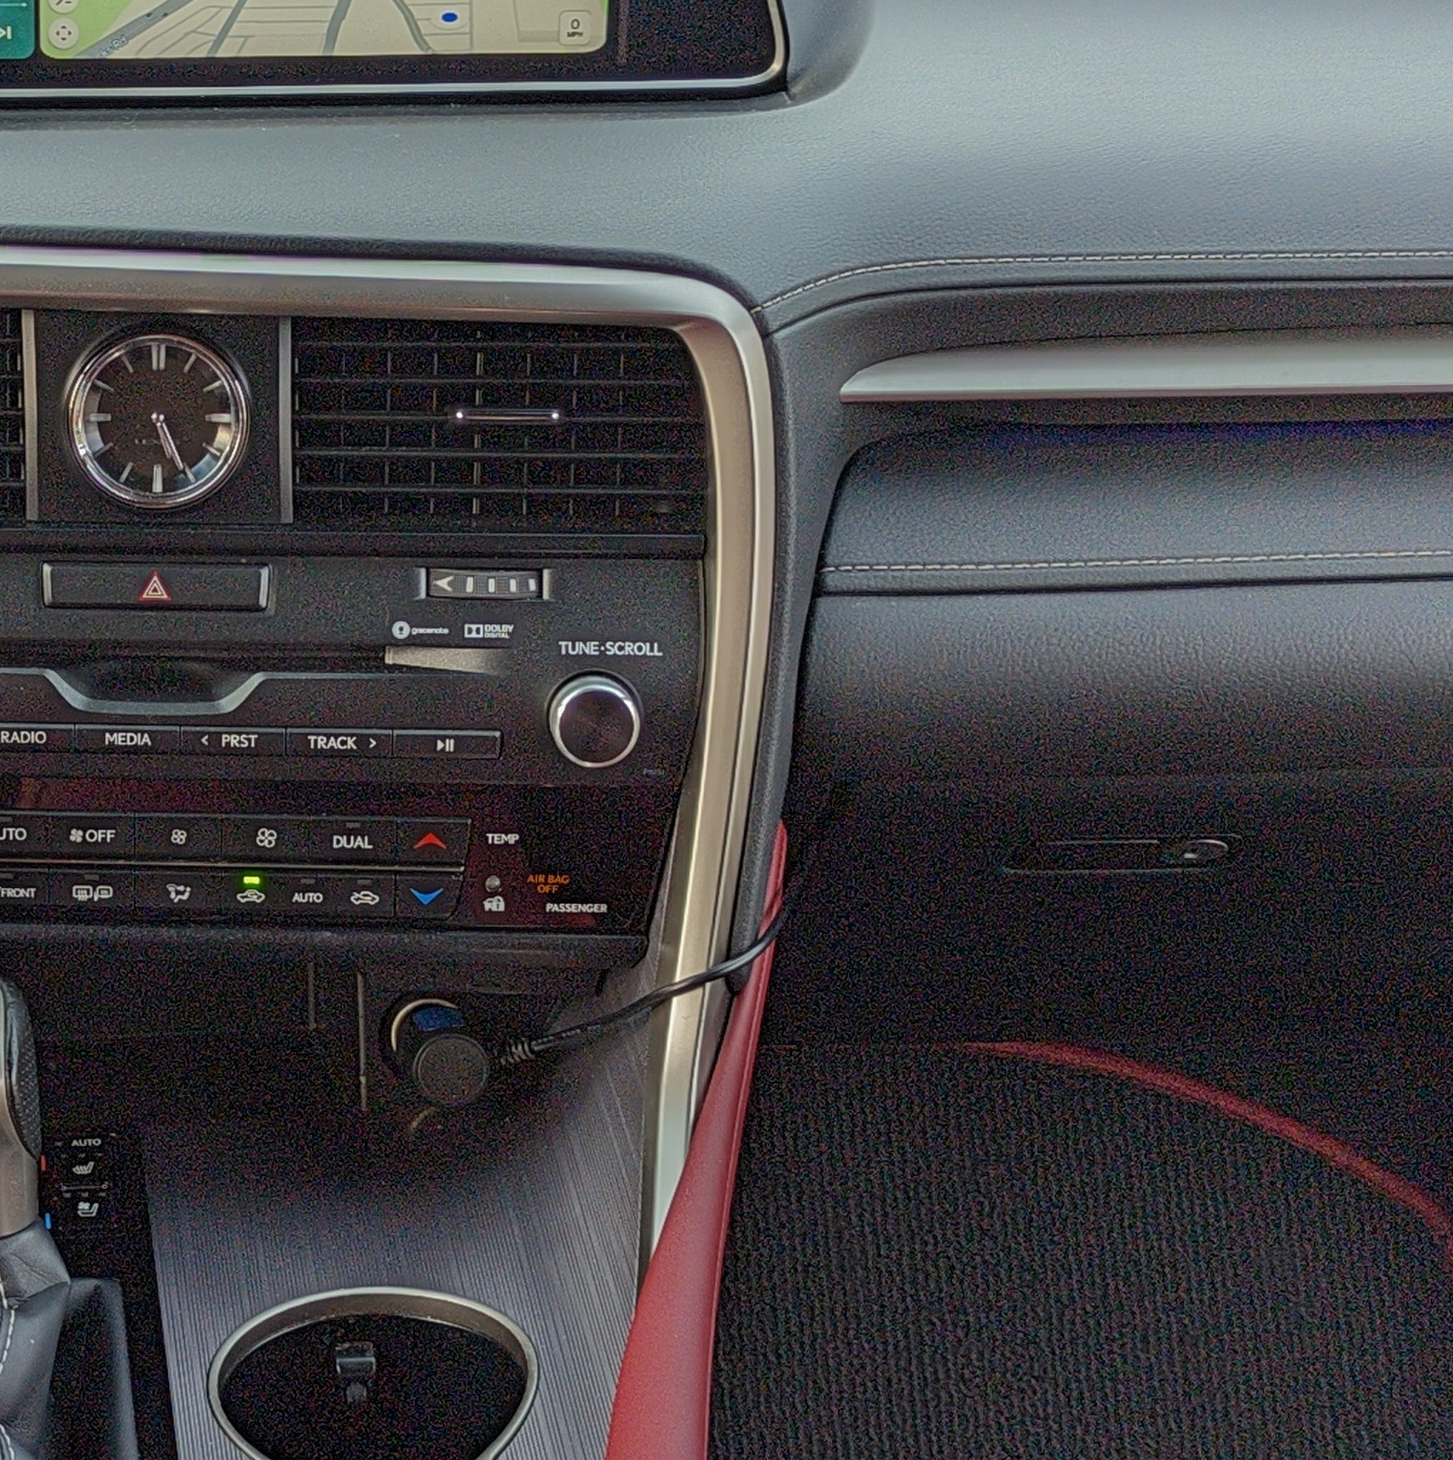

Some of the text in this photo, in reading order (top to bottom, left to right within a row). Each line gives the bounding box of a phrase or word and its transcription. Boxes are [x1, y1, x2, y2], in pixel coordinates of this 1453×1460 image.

[571, 19, 580, 30] 0
[484, 624, 514, 632] DOLBY
[0, 730, 47, 745] RADIO
[105, 732, 151, 747] MEDIA
[221, 734, 258, 749] PRST
[307, 736, 357, 751] TRACK
[85, 829, 116, 843] OFF
[332, 835, 373, 849] DUAL
[486, 833, 520, 845] TEMP
[527, 874, 570, 885] AIR BAG
[0, 887, 37, 899] FRONT
[537, 885, 558, 894] OFF
[292, 892, 323, 903] AUTO
[546, 902, 607, 914] PASSENGER
[71, 1138, 102, 1147] AUTO
